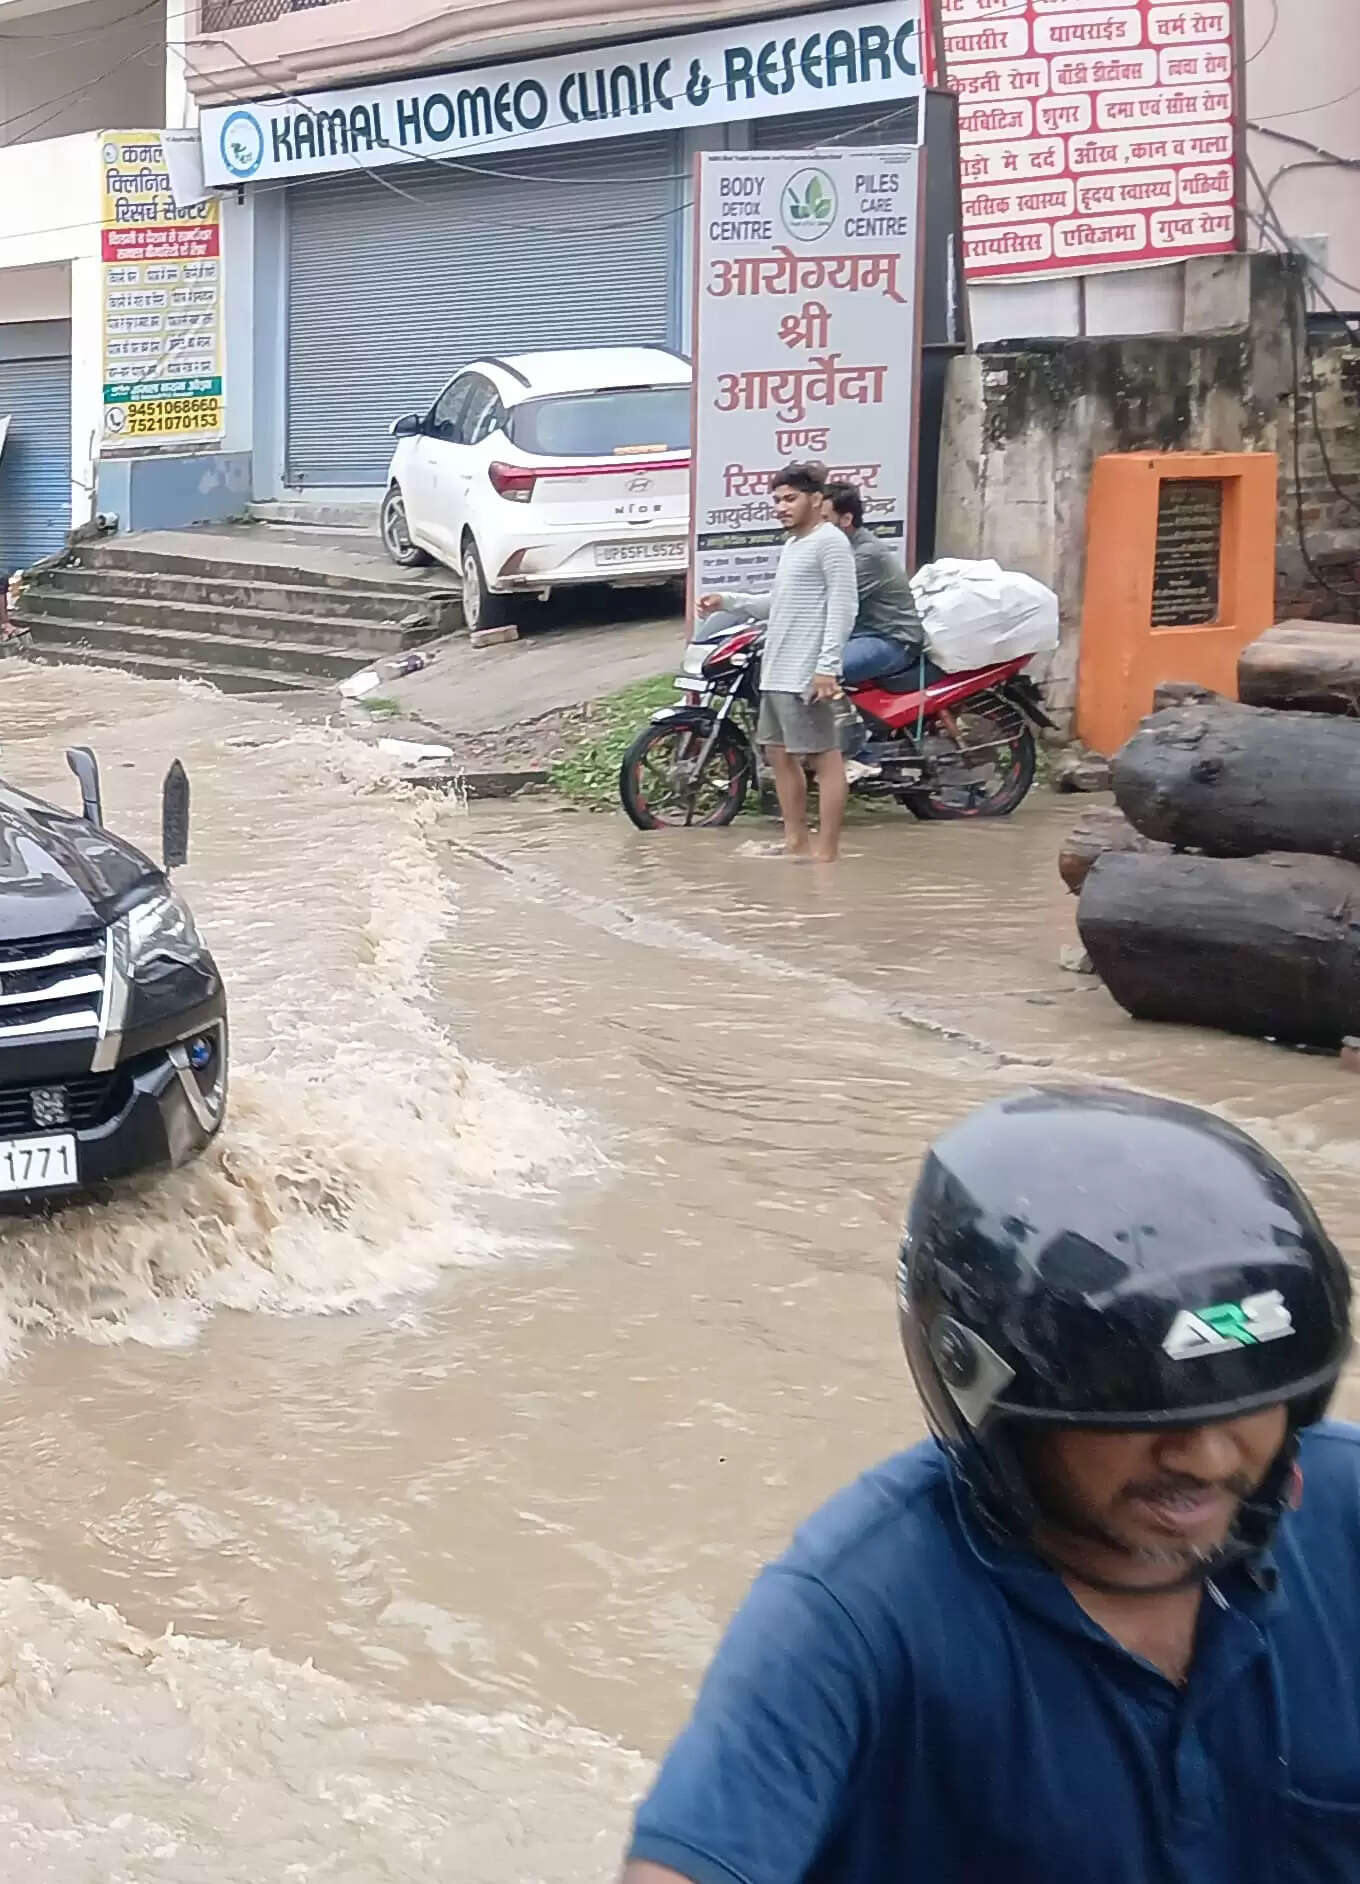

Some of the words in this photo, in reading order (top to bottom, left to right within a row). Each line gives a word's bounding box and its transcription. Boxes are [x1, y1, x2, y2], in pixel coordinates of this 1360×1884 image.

[1156, 13, 1186, 35] चर्म
[1191, 12, 1223, 32] रोग
[1204, 52, 1228, 72] रोग
[271, 102, 388, 163] KAMAL
[398, 79, 548, 146] HOMEO
[560, 57, 673, 121] CLINIC
[686, 58, 711, 106] &
[724, 19, 920, 101] RESEARC
[1008, 69, 1040, 90] रोग
[1105, 102, 1133, 119] दमा
[1139, 94, 1162, 117] एवं
[1202, 90, 1229, 111] रोग
[1041, 106, 1080, 130] शुगर
[1028, 146, 1055, 169] दर्द
[1172, 140, 1185, 156] व
[1190, 136, 1229, 154] गला
[720, 177, 765, 196] BODY
[856, 174, 898, 193] PILES
[722, 202, 760, 216] DETOX
[860, 198, 892, 212] CARE
[962, 194, 1011, 216] नसिक
[1080, 186, 1114, 210] हृदय
[710, 221, 772, 240] CENTRE
[845, 217, 907, 237] CENTRE
[1156, 218, 1194, 242] गुप्त
[1199, 213, 1232, 233] रोग
[706, 245, 905, 303] आरोग्यम्
[778, 301, 832, 349] श्री
[714, 353, 888, 423] आयुर्वेदा
[128, 414, 218, 433] 7521070153
[775, 428, 830, 455] एण्ड
[1161, 1289, 1296, 1360] ARS
